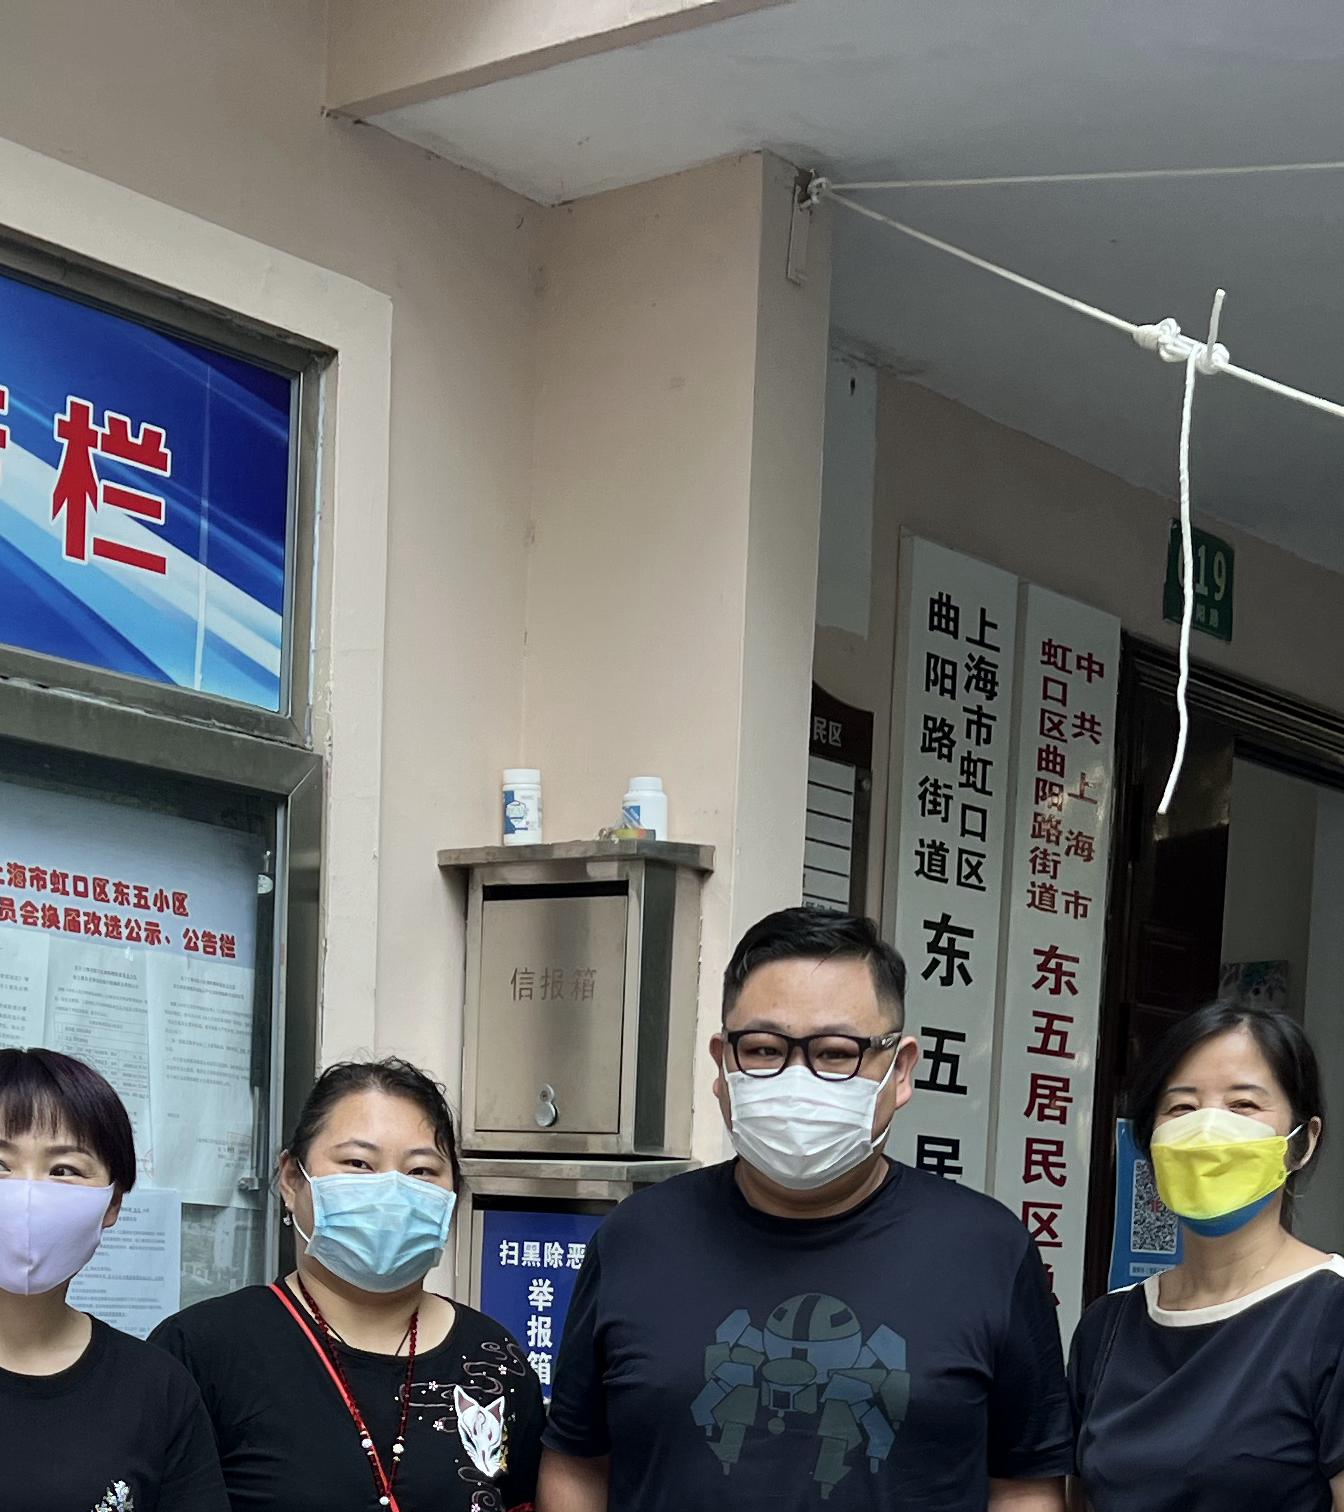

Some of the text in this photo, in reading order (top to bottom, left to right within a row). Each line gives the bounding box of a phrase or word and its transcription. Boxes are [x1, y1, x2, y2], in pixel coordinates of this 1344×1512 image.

[914, 592, 960, 886] 曲阳路街道
[956, 606, 1002, 893] 上海市虹口区
[1026, 638, 1073, 914] 虹口区曲阳路街道
[510, 966, 598, 1002] 信报箱
[499, 1240, 586, 1270] 扫黑除恶
[526, 1278, 555, 1386] 举报箱
